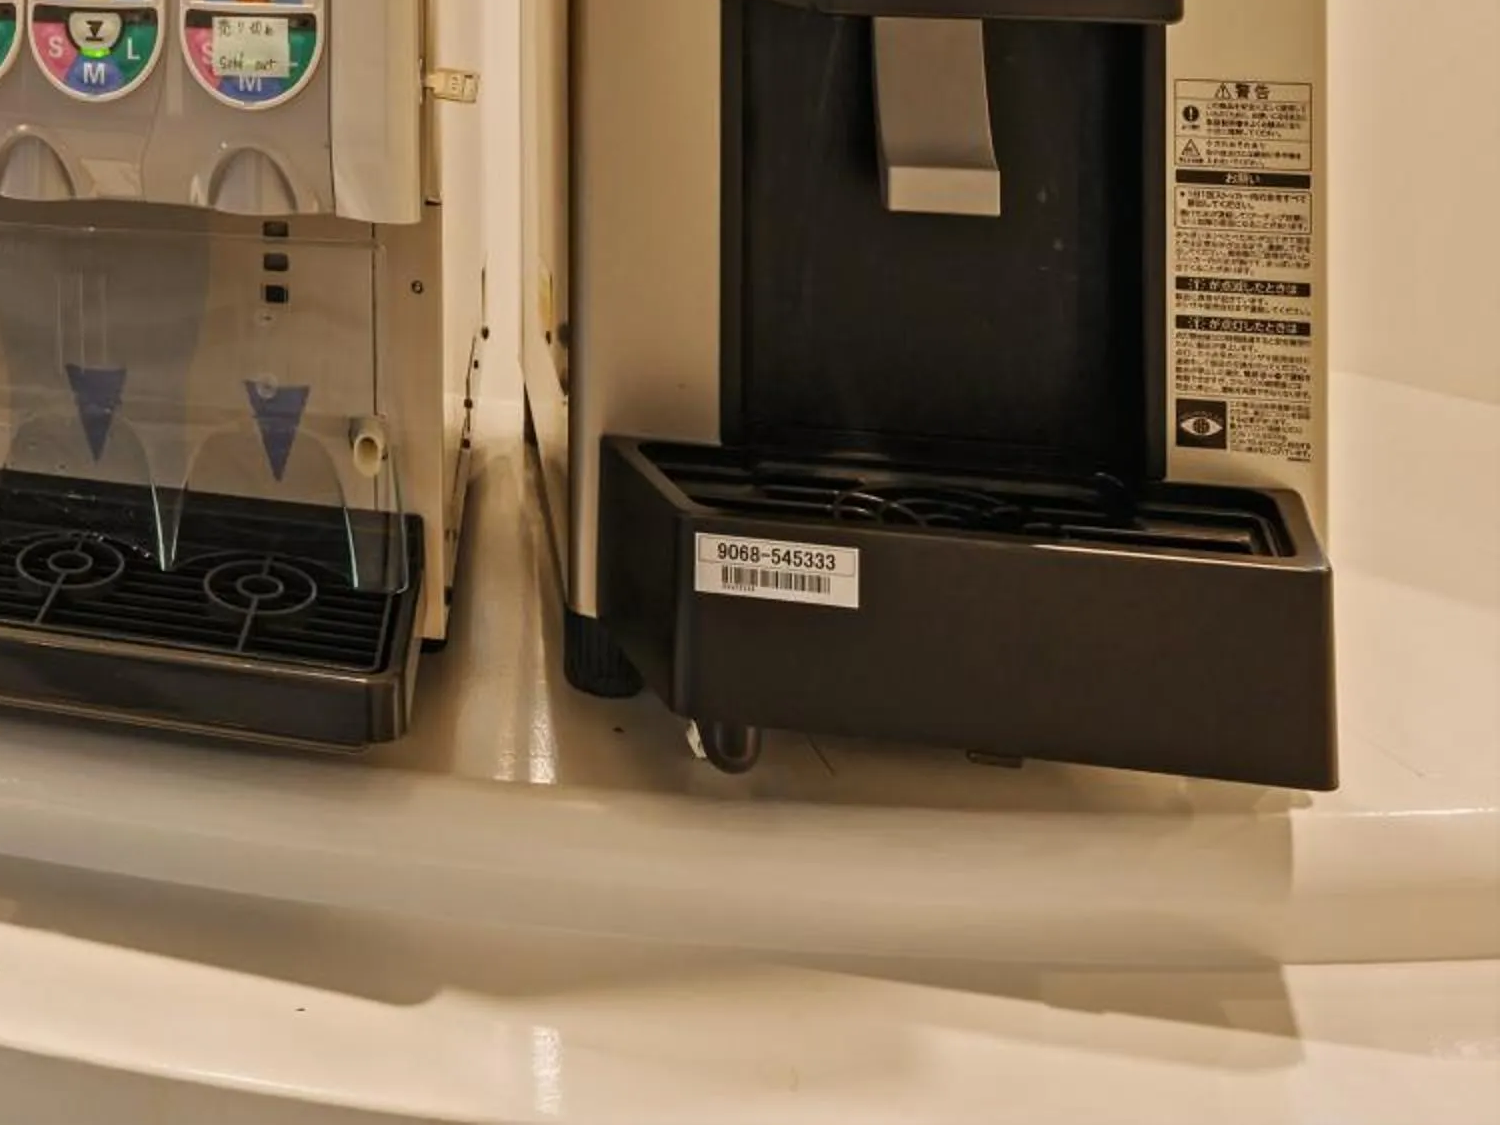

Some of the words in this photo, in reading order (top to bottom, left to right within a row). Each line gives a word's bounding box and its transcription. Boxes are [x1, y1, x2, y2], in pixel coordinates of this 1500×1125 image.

[48, 35, 64, 58] S
[127, 38, 140, 60] L
[83, 62, 105, 85] M
[717, 542, 837, 572] 9068-545333
